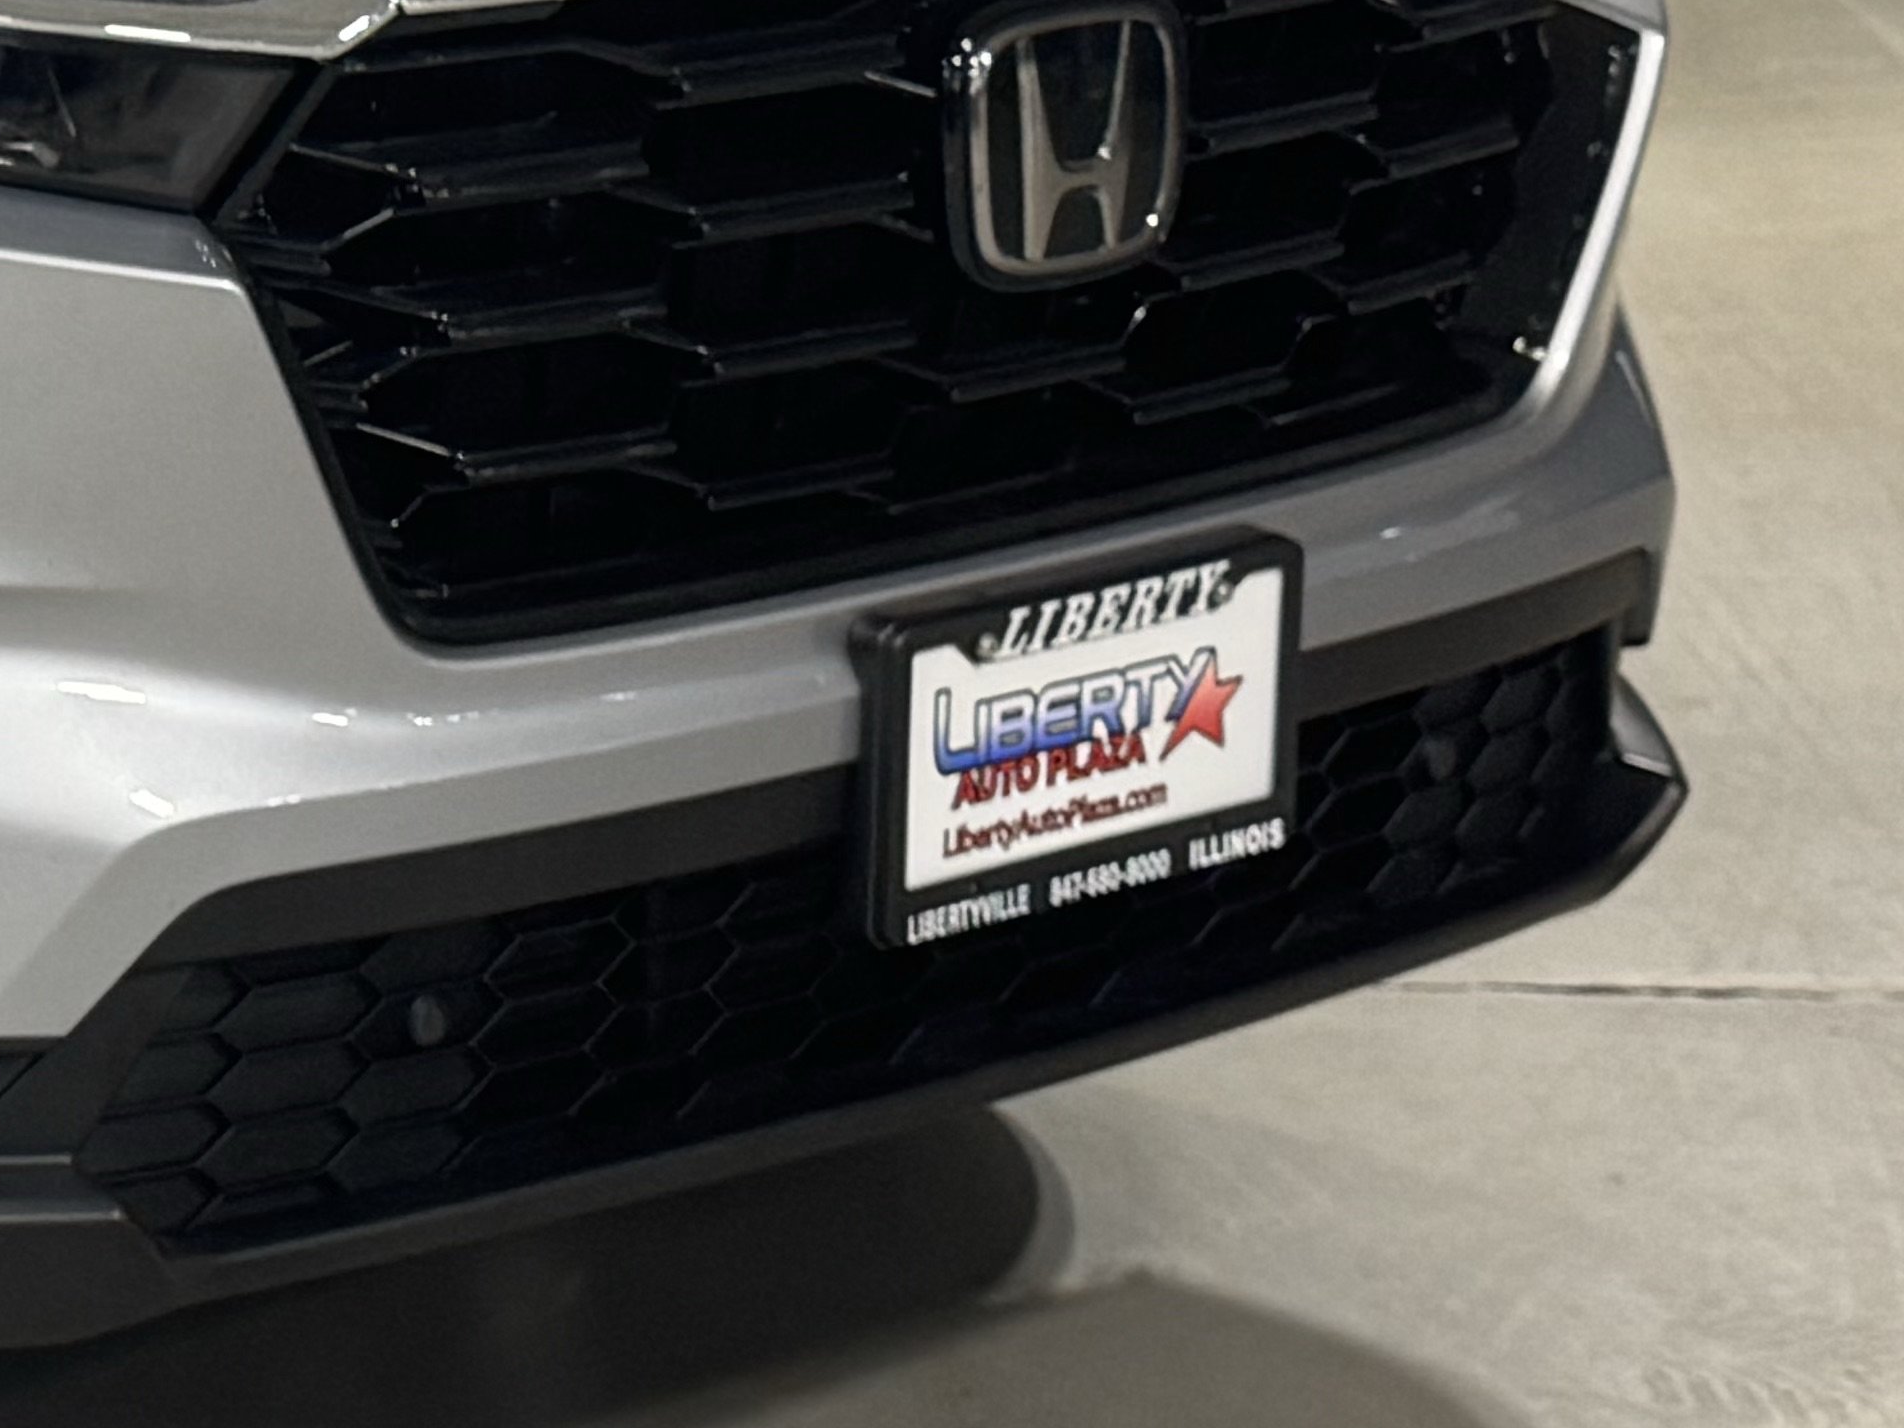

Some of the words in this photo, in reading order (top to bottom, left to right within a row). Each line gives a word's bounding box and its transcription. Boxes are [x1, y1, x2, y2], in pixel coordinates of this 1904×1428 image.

[995, 559, 1230, 657] LIBERTY
[934, 646, 1216, 775] LIBERTY
[951, 754, 1040, 810] AUTO
[1046, 732, 1146, 787] PLAZA
[942, 783, 1167, 859] LibertyAutoPlaza.com
[907, 884, 1031, 945] LIBERTYVILLE
[1188, 817, 1286, 870] ILLINOIS
